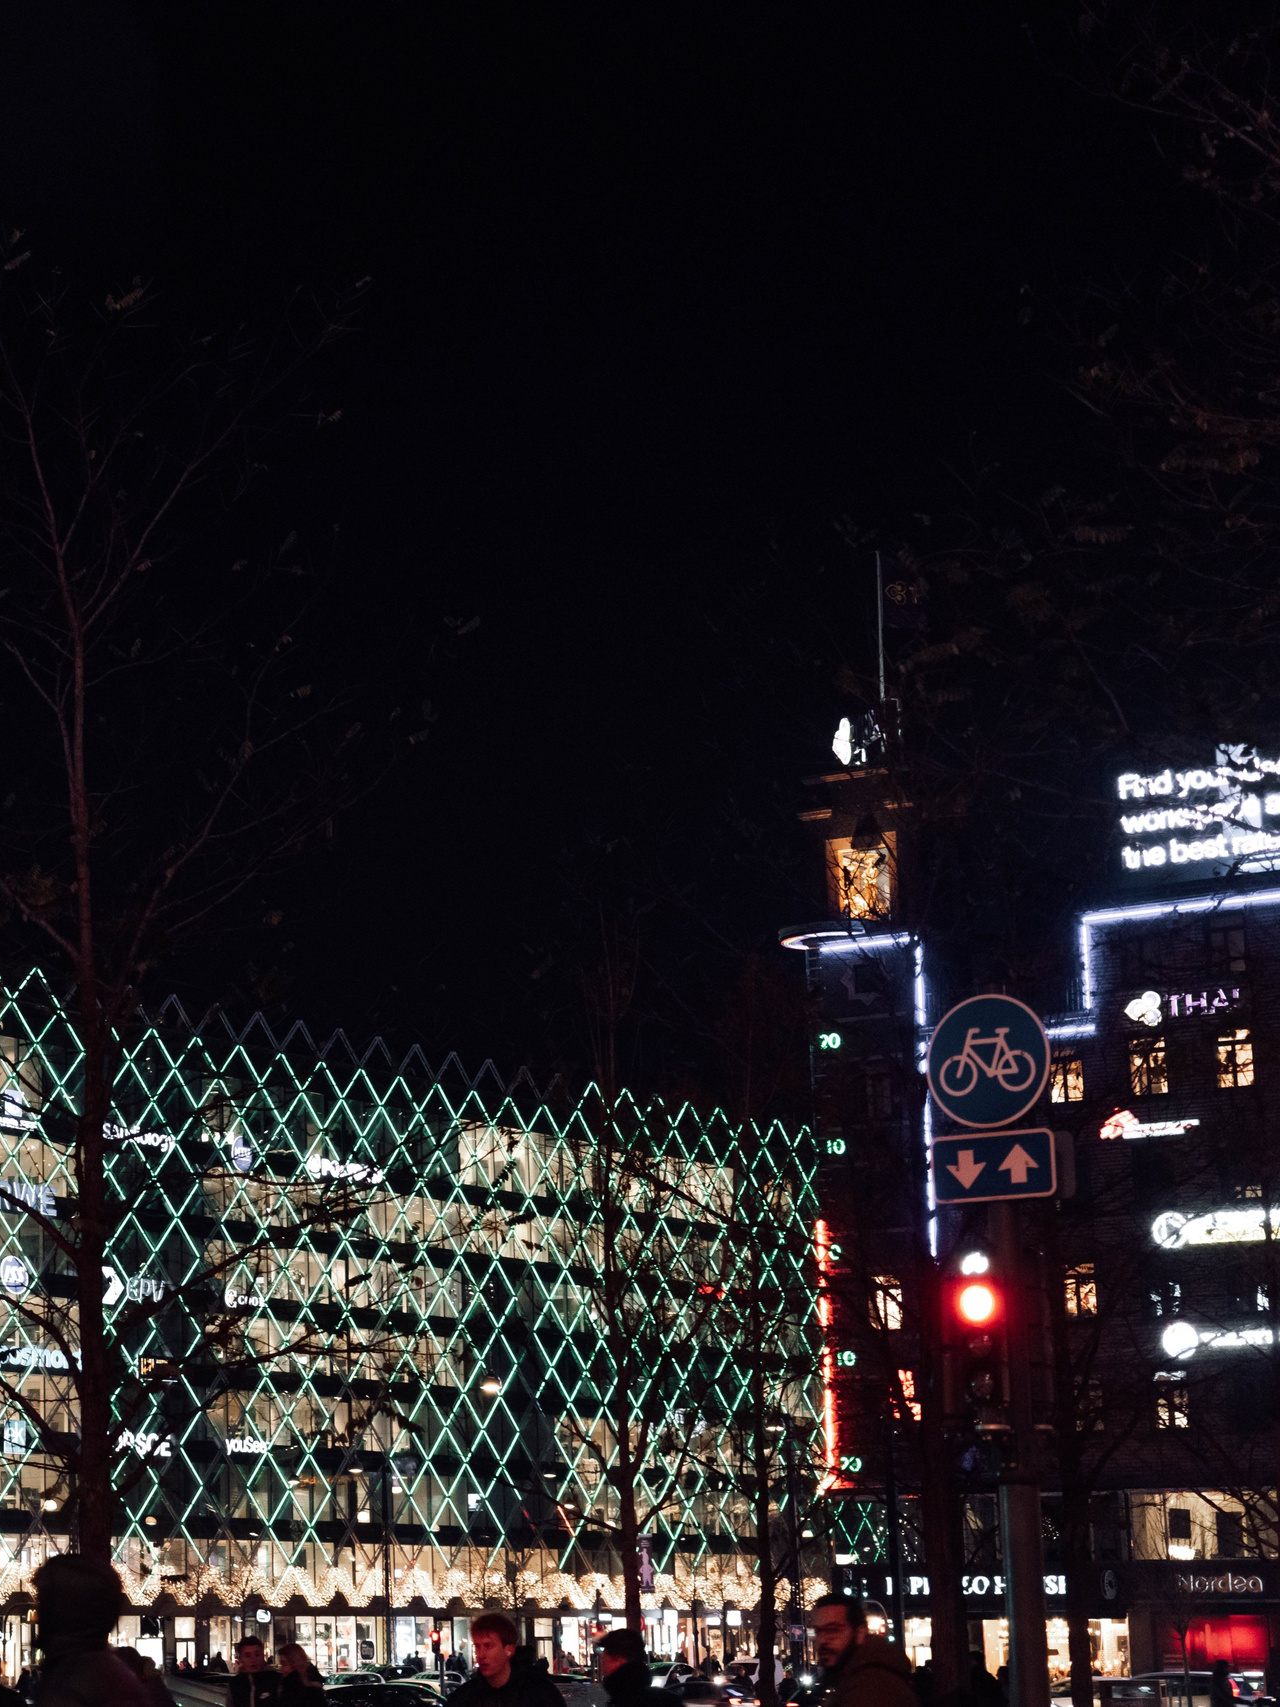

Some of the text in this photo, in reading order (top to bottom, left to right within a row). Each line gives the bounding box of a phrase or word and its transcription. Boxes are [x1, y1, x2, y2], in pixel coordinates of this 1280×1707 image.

[3, 1264, 26, 1284] ISS
[226, 1437, 266, 1455] youSee
[1176, 1572, 1263, 1593] Nordea
